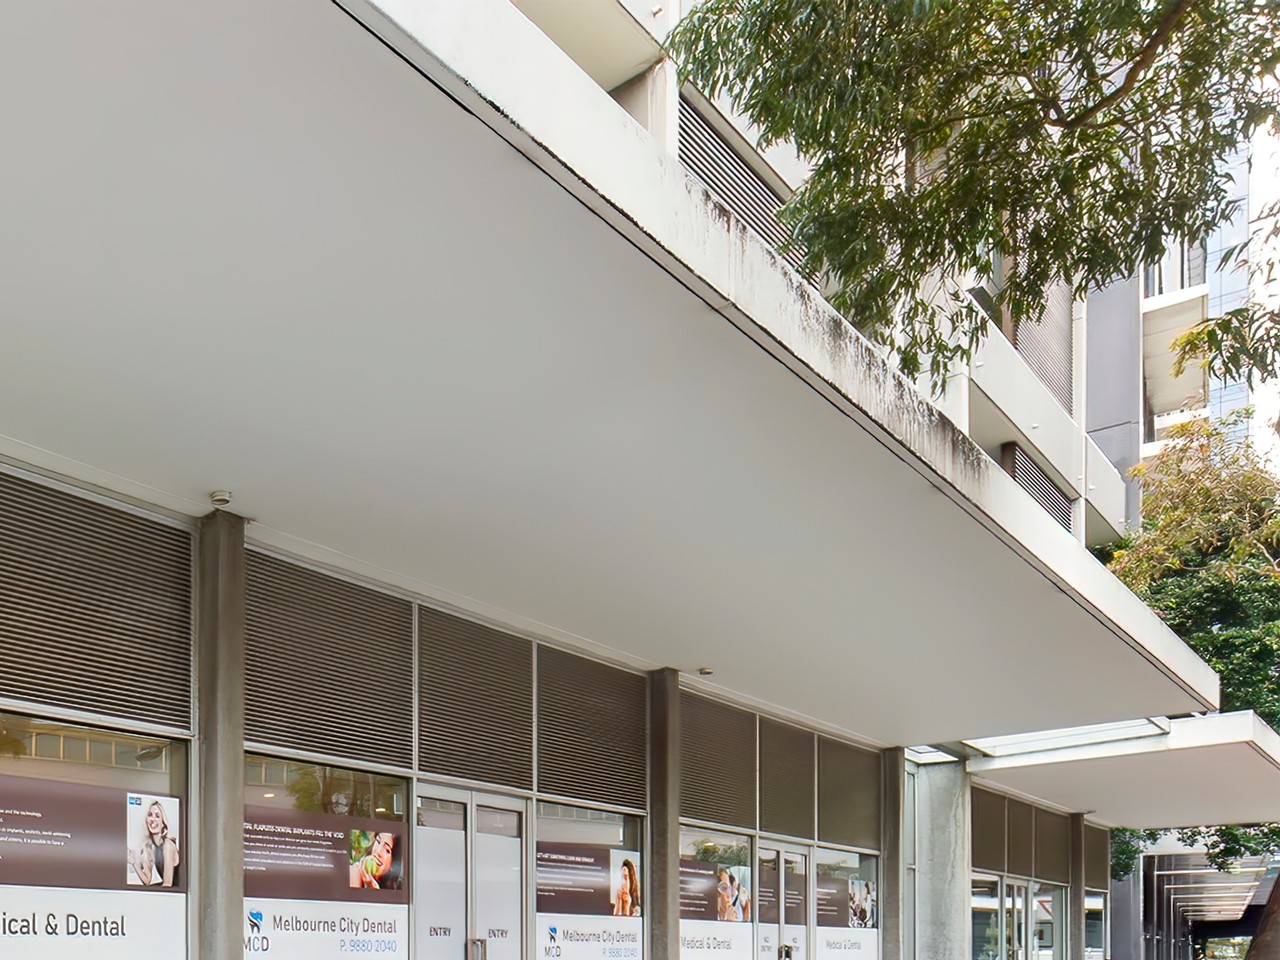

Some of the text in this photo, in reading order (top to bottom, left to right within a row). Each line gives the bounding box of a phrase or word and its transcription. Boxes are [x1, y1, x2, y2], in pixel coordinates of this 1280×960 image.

[45, 913, 58, 934] &
[66, 914, 126, 937] Dental
[273, 915, 397, 936] Melbourne City Dental
[430, 927, 451, 937] ENTRY
[488, 929, 508, 938] ENTRY
[563, 930, 637, 945] Melbourne City Dental
[243, 936, 269, 951] MCD
[340, 940, 397, 952] P. 9880 2040
